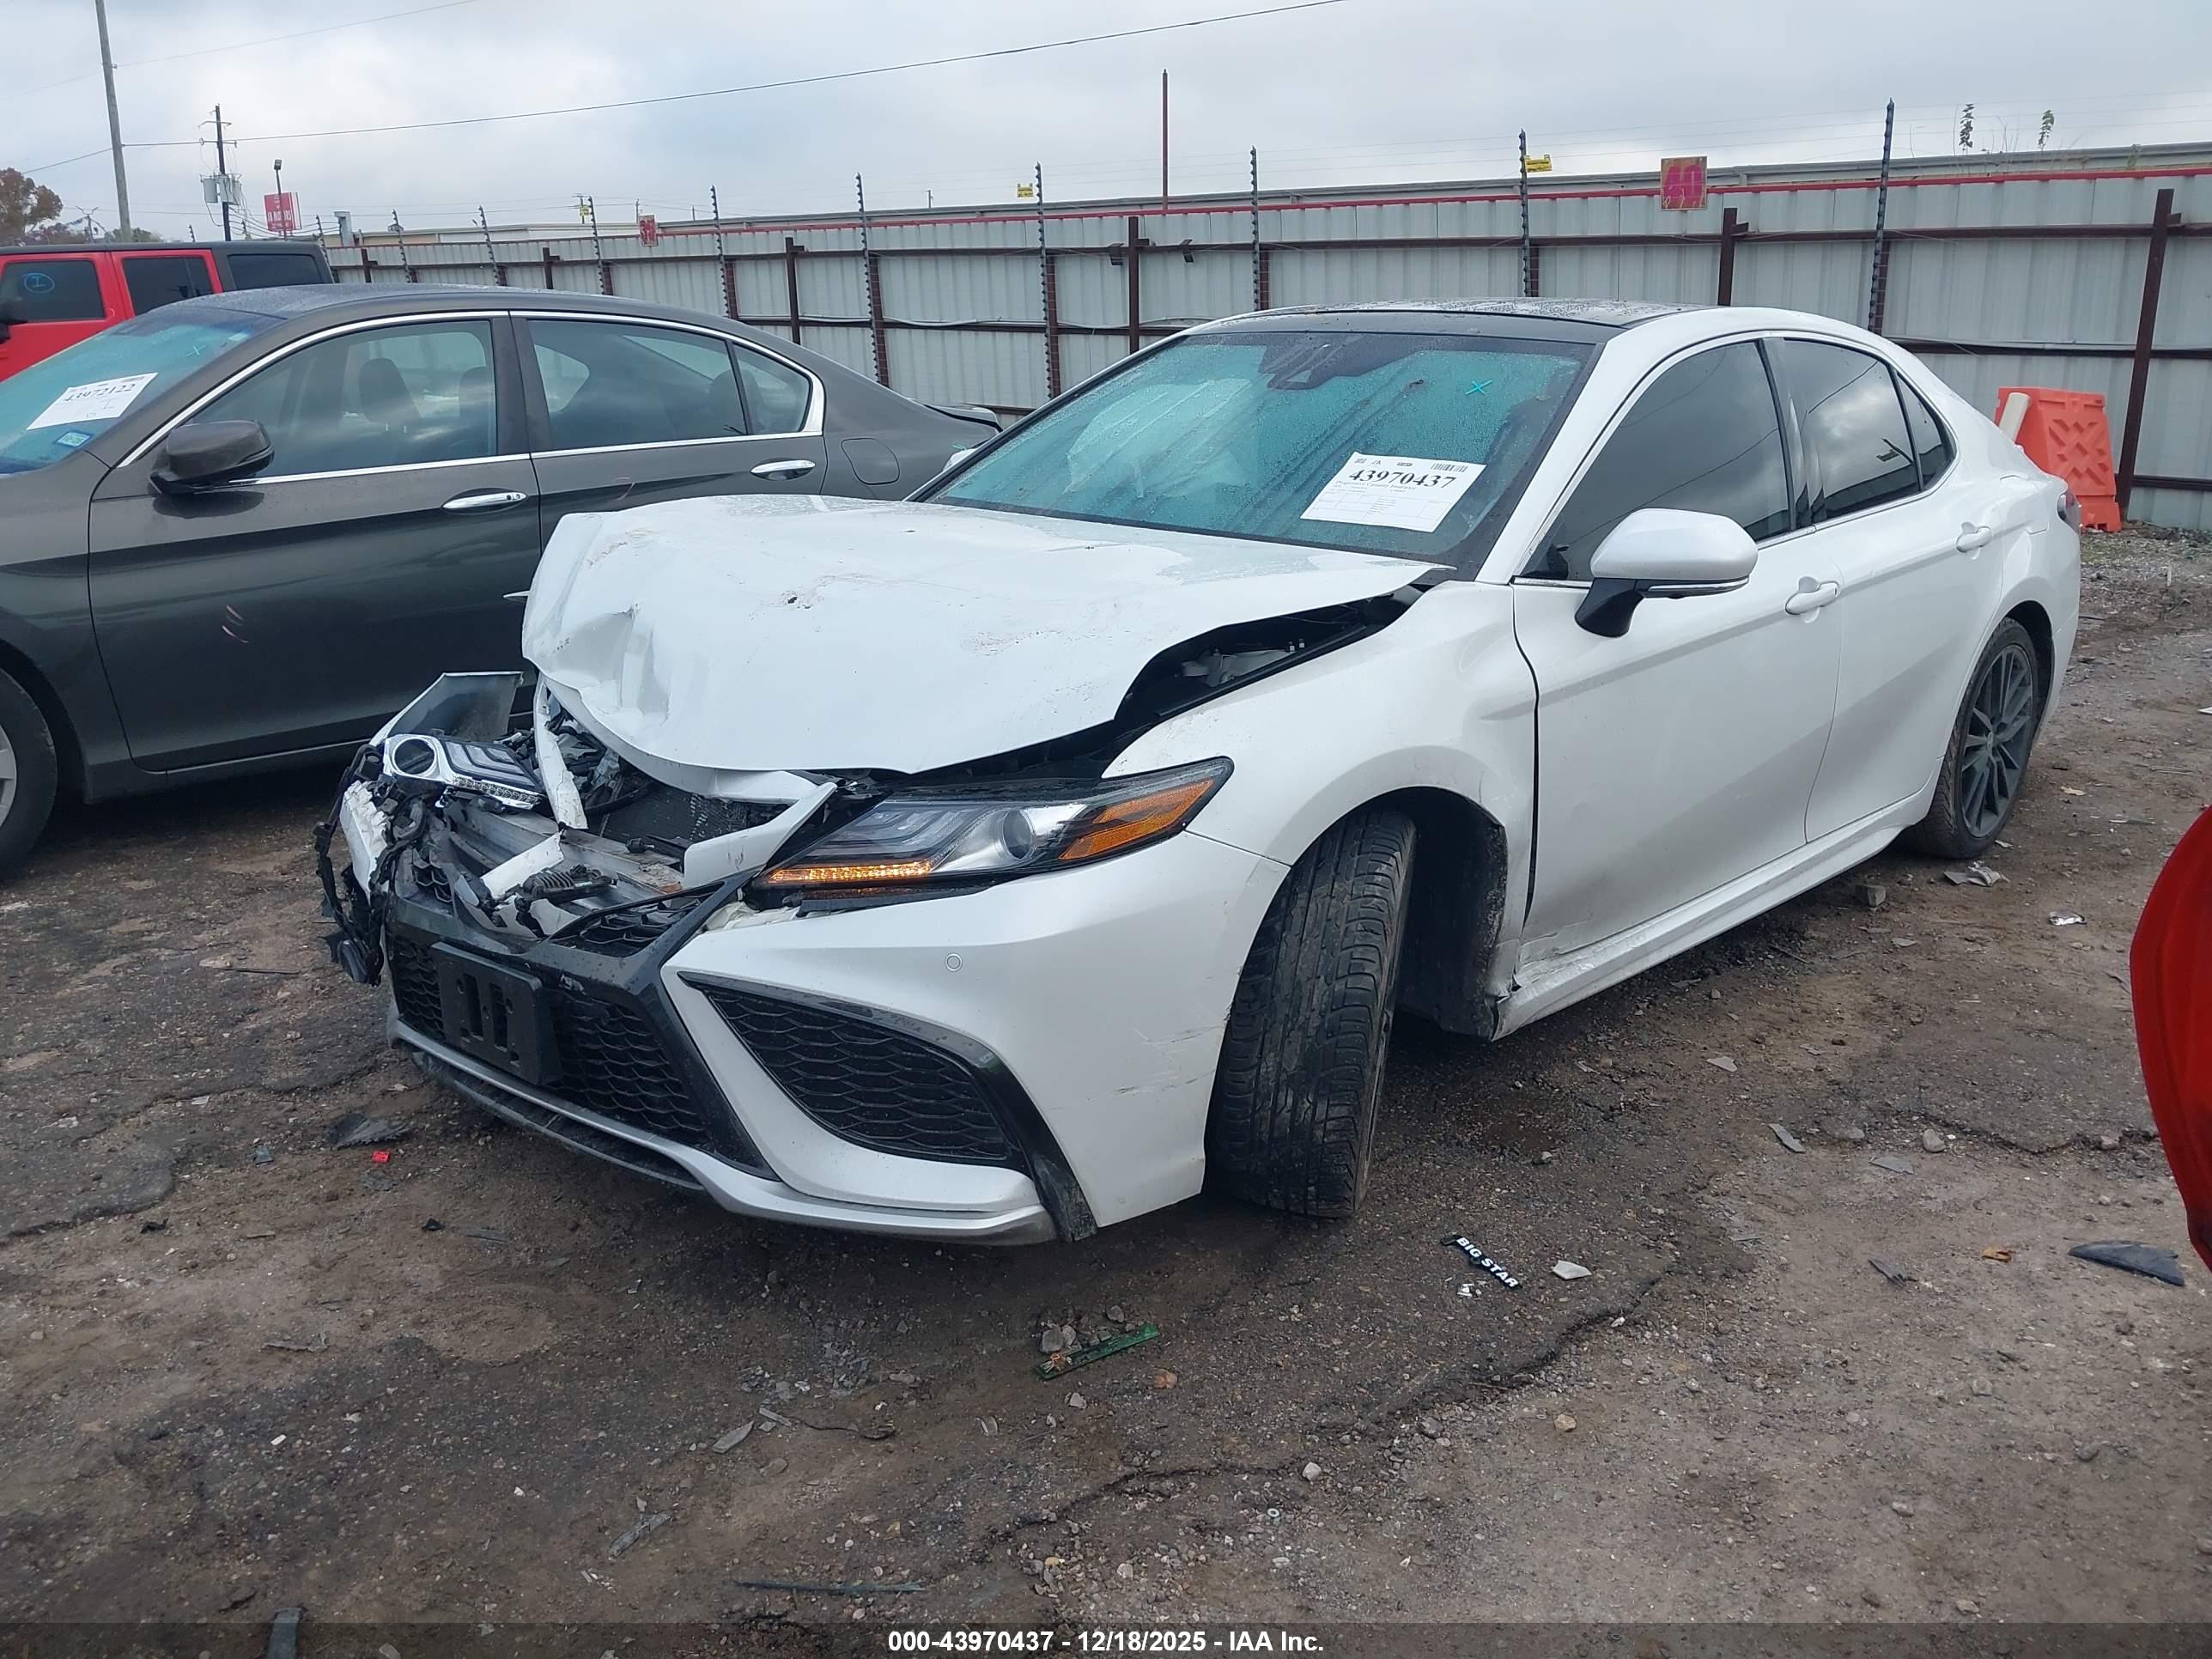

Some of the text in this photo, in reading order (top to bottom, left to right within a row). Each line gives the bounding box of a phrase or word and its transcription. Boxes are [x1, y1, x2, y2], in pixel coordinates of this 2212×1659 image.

[1349, 469, 1457, 489] 43970437
[1456, 1237, 1519, 1288] BIG STAR
